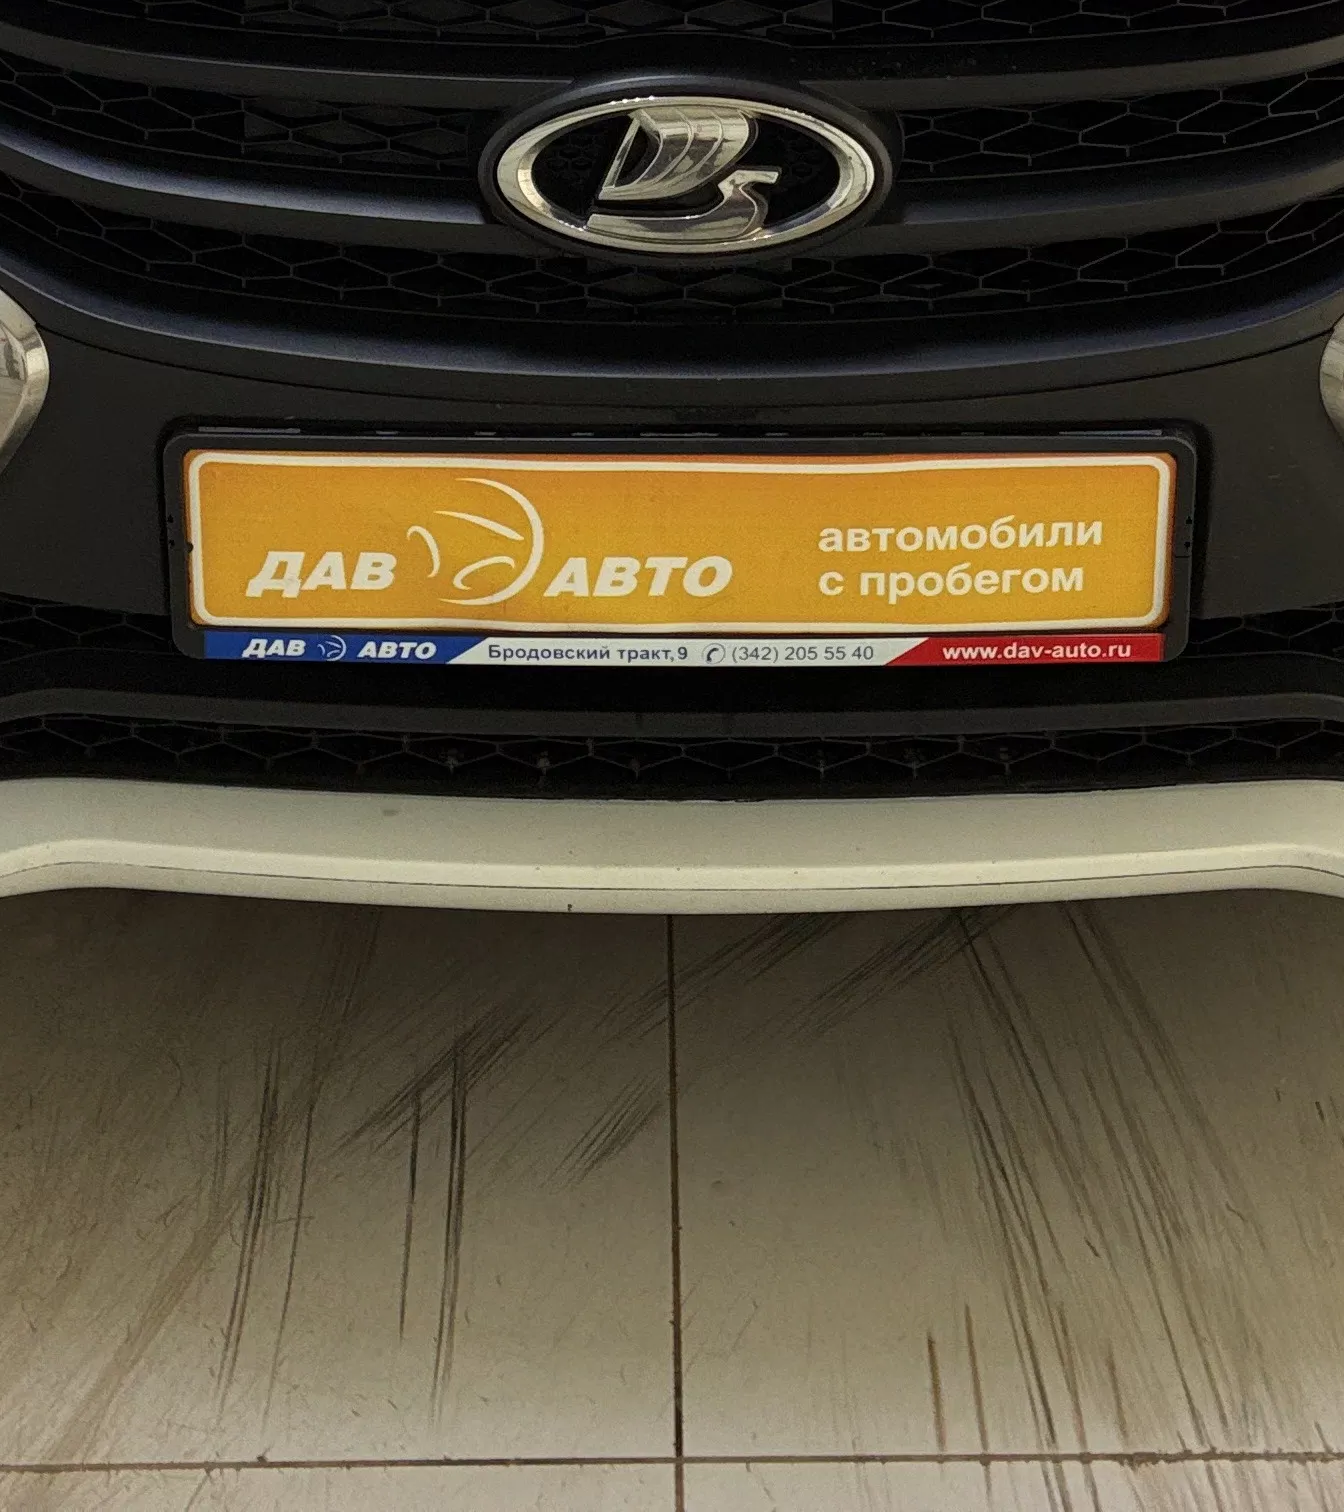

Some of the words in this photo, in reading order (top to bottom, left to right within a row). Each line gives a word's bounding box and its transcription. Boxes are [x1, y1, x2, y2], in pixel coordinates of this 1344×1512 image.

[818, 515, 1103, 552] автомобили
[246, 551, 397, 598] ДАВ
[543, 555, 733, 598] АВТО
[818, 570, 845, 596] с
[859, 562, 1084, 605] пробегом
[241, 638, 306, 660] ДАВ
[358, 640, 437, 660] АВТО
[488, 644, 611, 661] Бродовский
[732, 644, 779, 662] (342)
[784, 645, 818, 661] 205
[824, 645, 846, 660] 55
[851, 645, 874, 660] 40
[942, 641, 1131, 661] www.dav-auto.ru
